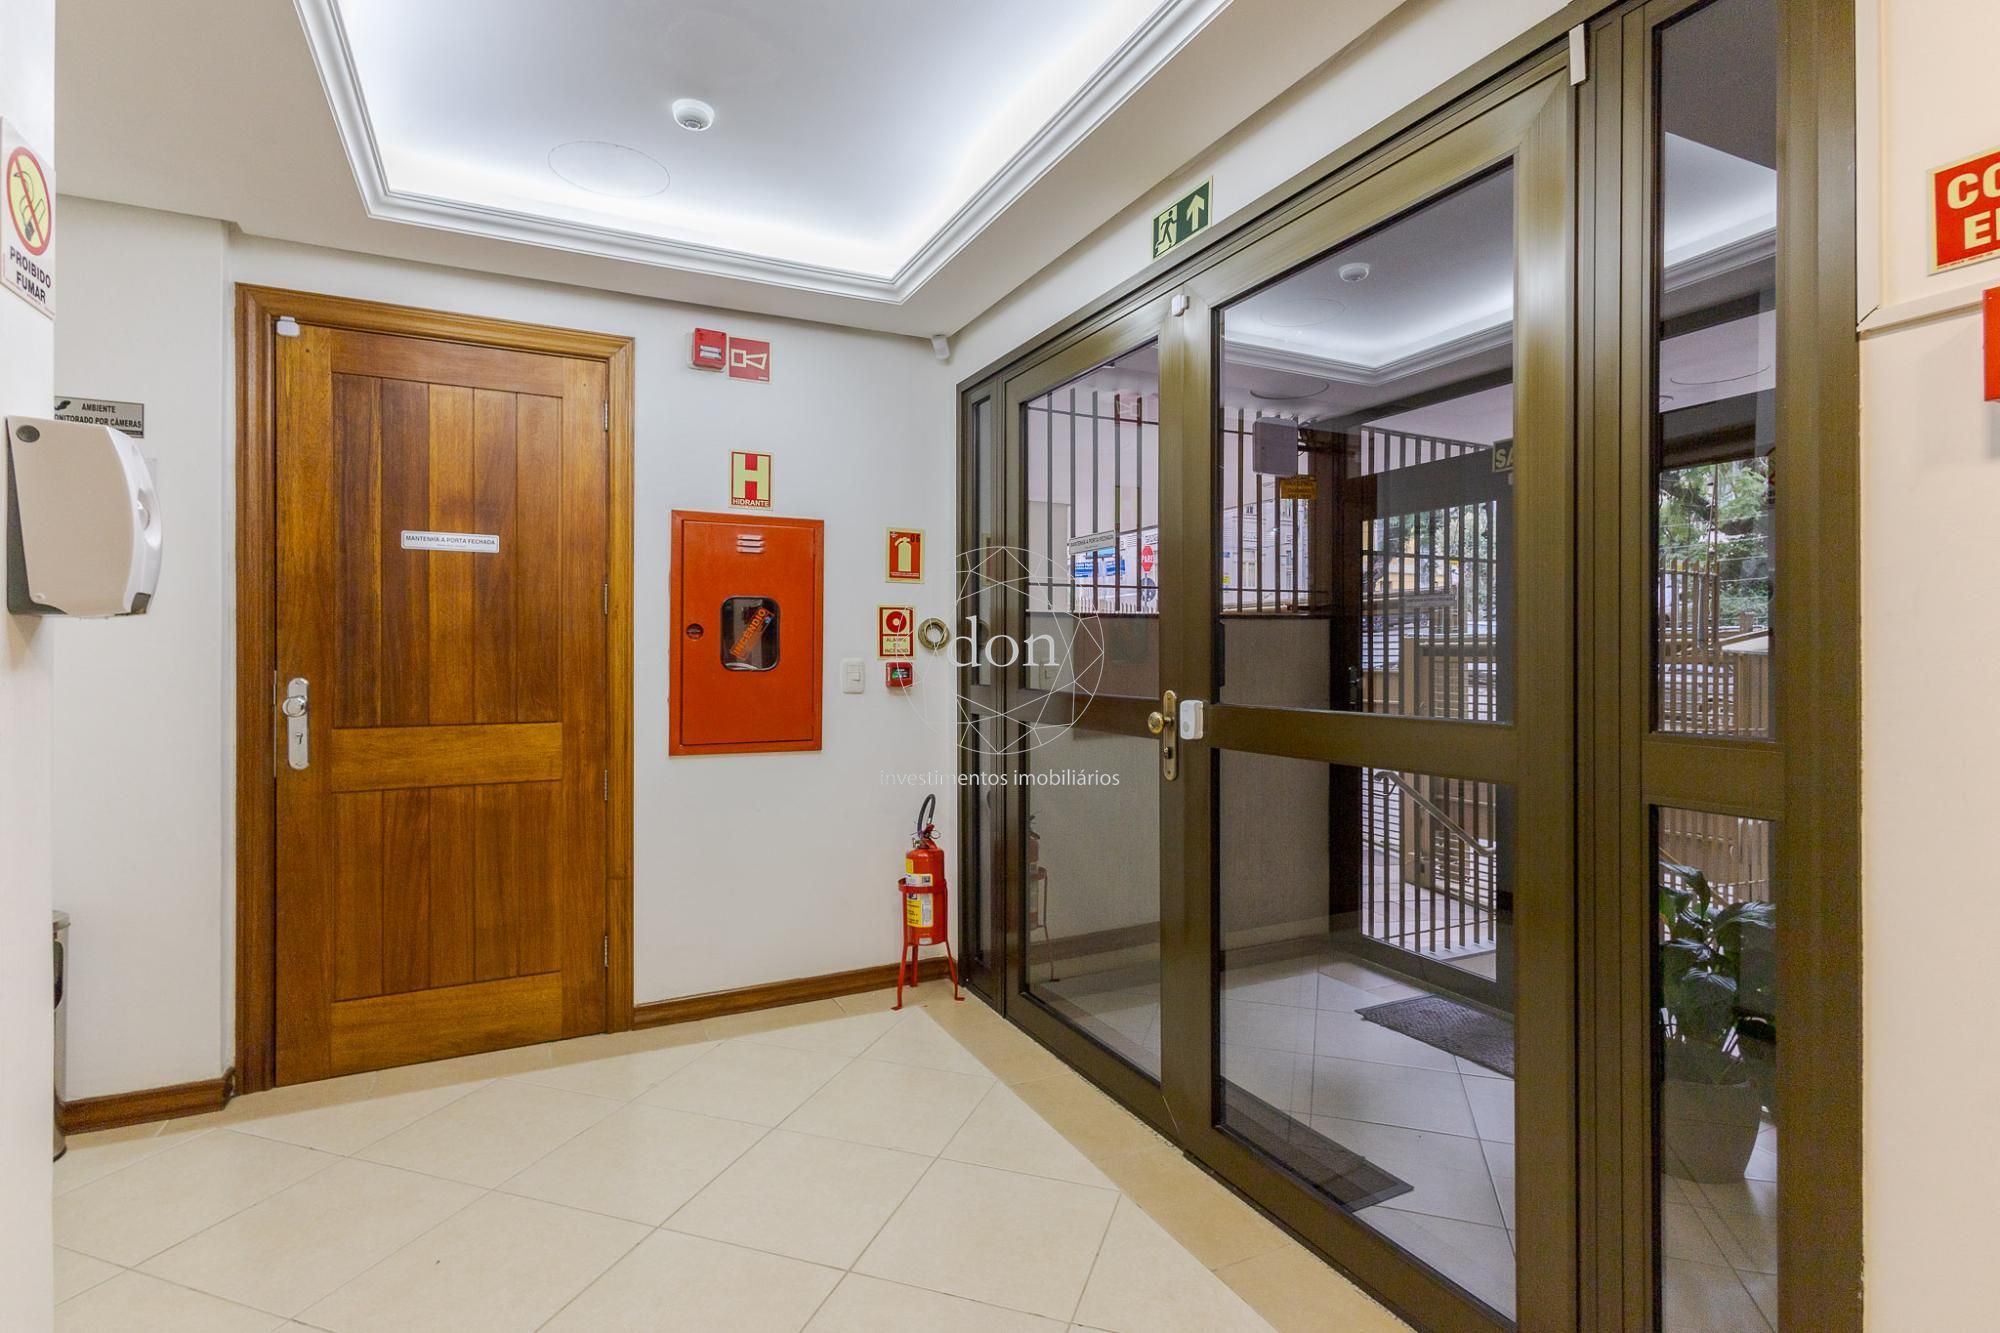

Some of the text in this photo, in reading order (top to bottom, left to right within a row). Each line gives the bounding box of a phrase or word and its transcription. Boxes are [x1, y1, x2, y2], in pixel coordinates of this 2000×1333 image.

[1964, 207, 2000, 249] E
[10, 246, 51, 288] PROIBIDO
[16, 271, 46, 303] FUMAR
[82, 403, 116, 413] AMBIENTE
[54, 414, 94, 424] ONITORADO
[95, 418, 108, 426] POR
[732, 499, 769, 507] HIDRANTE
